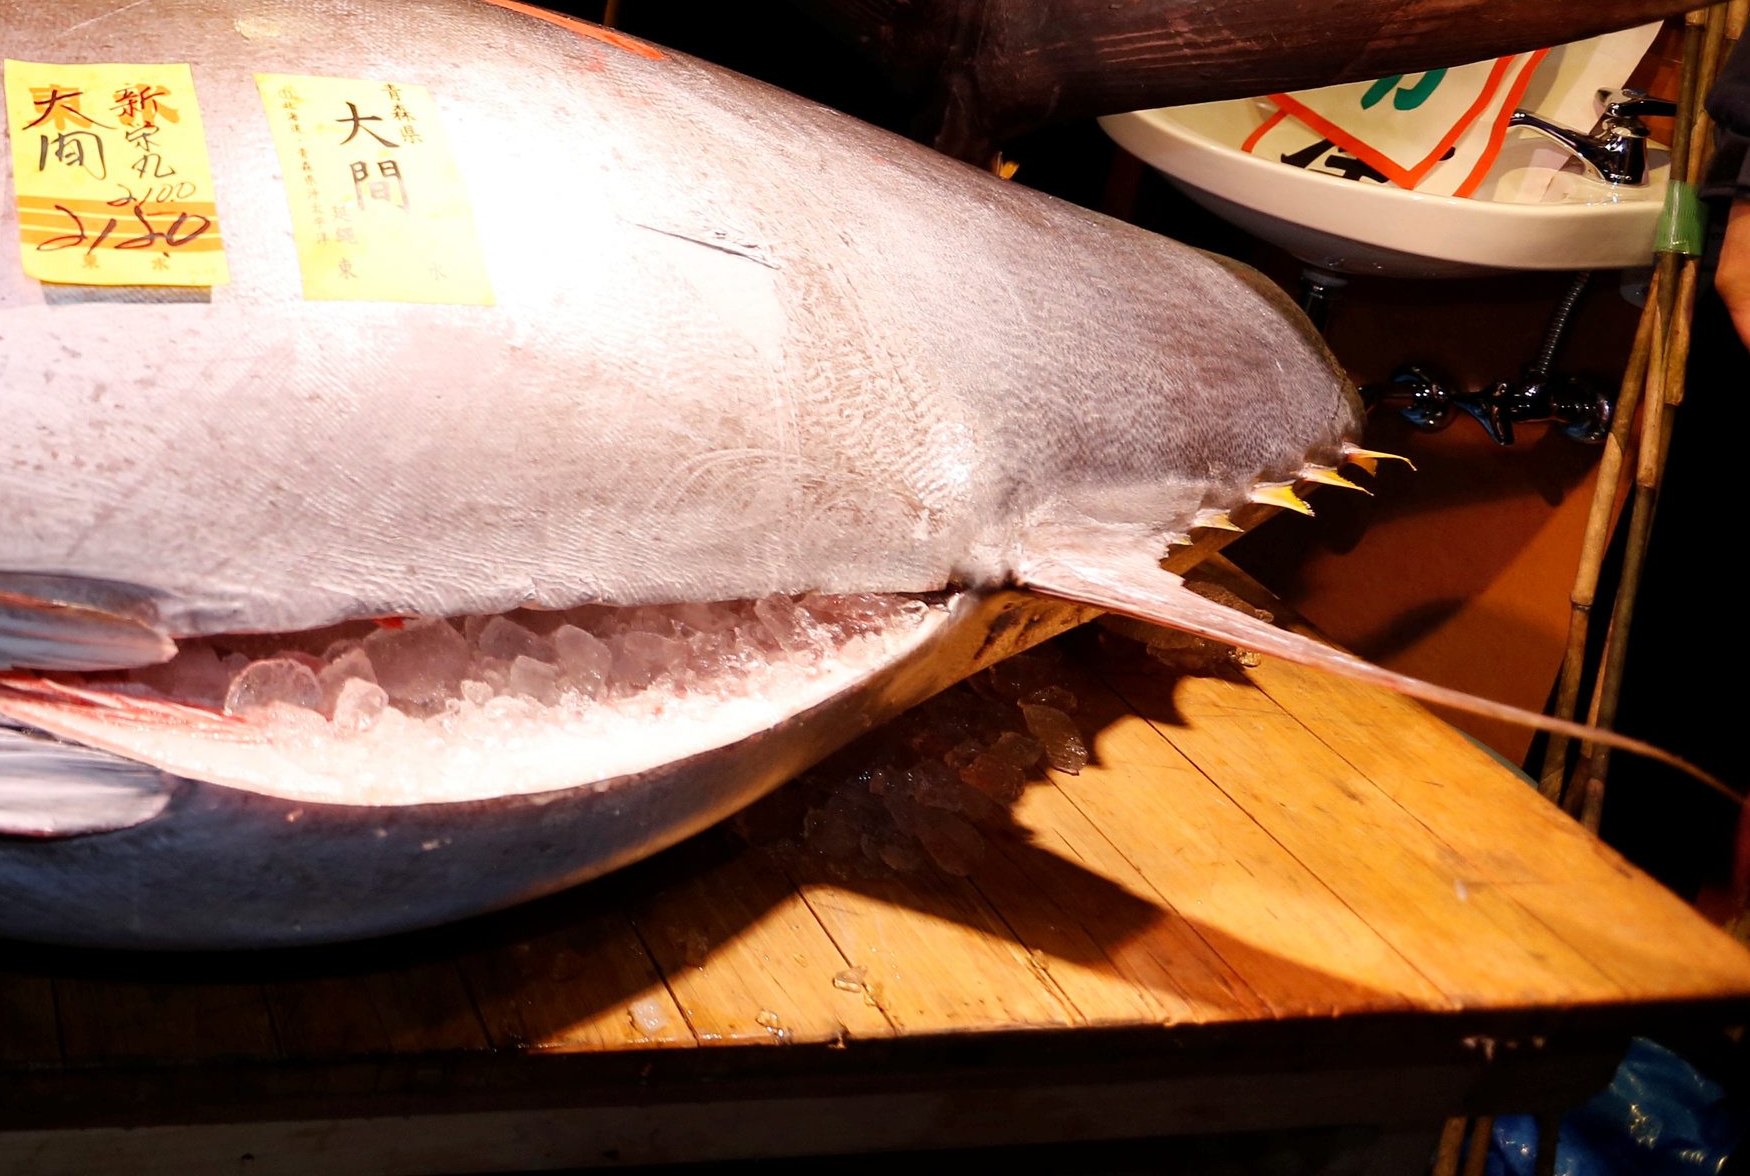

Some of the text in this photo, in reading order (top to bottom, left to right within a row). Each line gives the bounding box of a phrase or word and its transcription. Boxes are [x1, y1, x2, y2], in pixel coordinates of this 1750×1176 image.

[335, 100, 411, 213] 大間
[381, 83, 424, 144] 青森県
